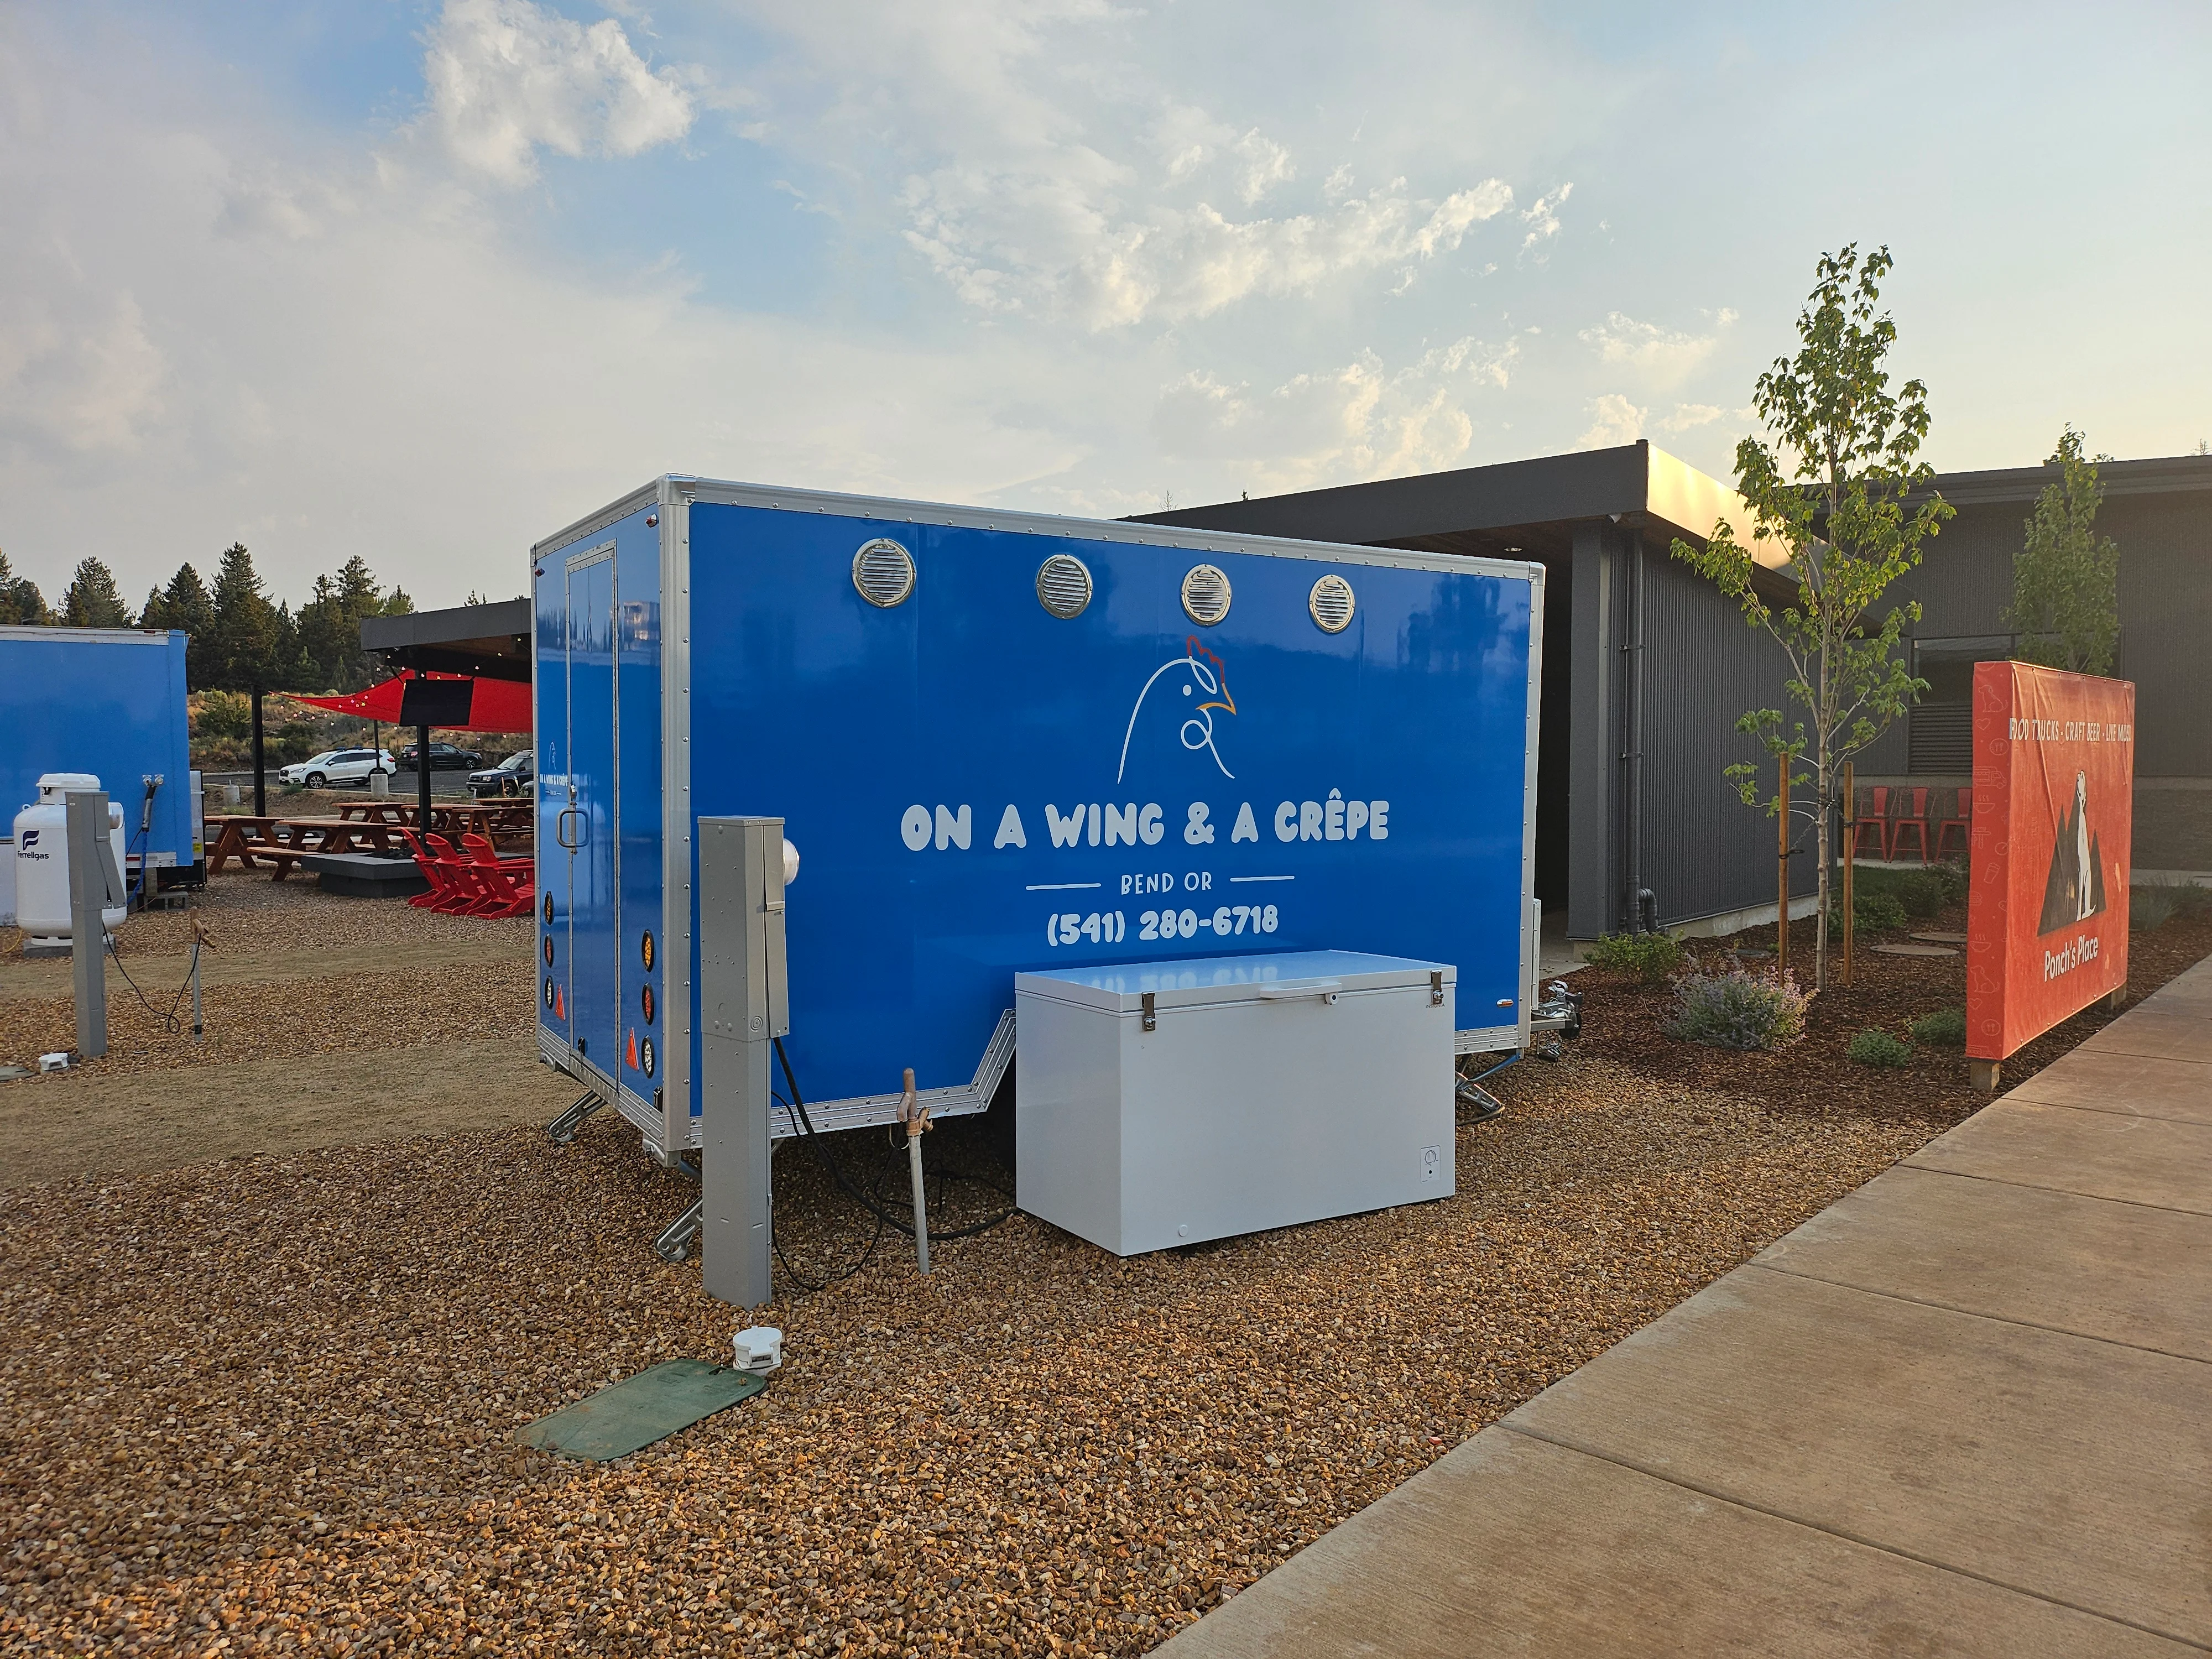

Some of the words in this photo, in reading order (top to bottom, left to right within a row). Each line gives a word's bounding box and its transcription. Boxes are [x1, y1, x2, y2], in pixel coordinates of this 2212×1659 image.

[2009, 718, 2029, 740] FOOD
[2032, 719, 2059, 741] TRUCKS
[2065, 721, 2085, 742] CRAFT
[2087, 722, 2100, 742] BEER
[2106, 723, 2116, 742] LIVE
[901, 804, 972, 852] ON
[994, 804, 1027, 849] A
[1045, 802, 1165, 848] WING
[1183, 801, 1215, 846] &
[1231, 802, 1259, 843] A
[1274, 787, 1390, 842] CRÊPE
[17, 851, 49, 861] Ferrellgas
[1120, 873, 1174, 895] BEND
[1184, 872, 1212, 891] OR
[1047, 910, 1125, 947] (541)
[1139, 904, 1279, 940] 280-6718
[2044, 940, 2076, 982] Ponch's
[2078, 934, 2098, 966] Place
